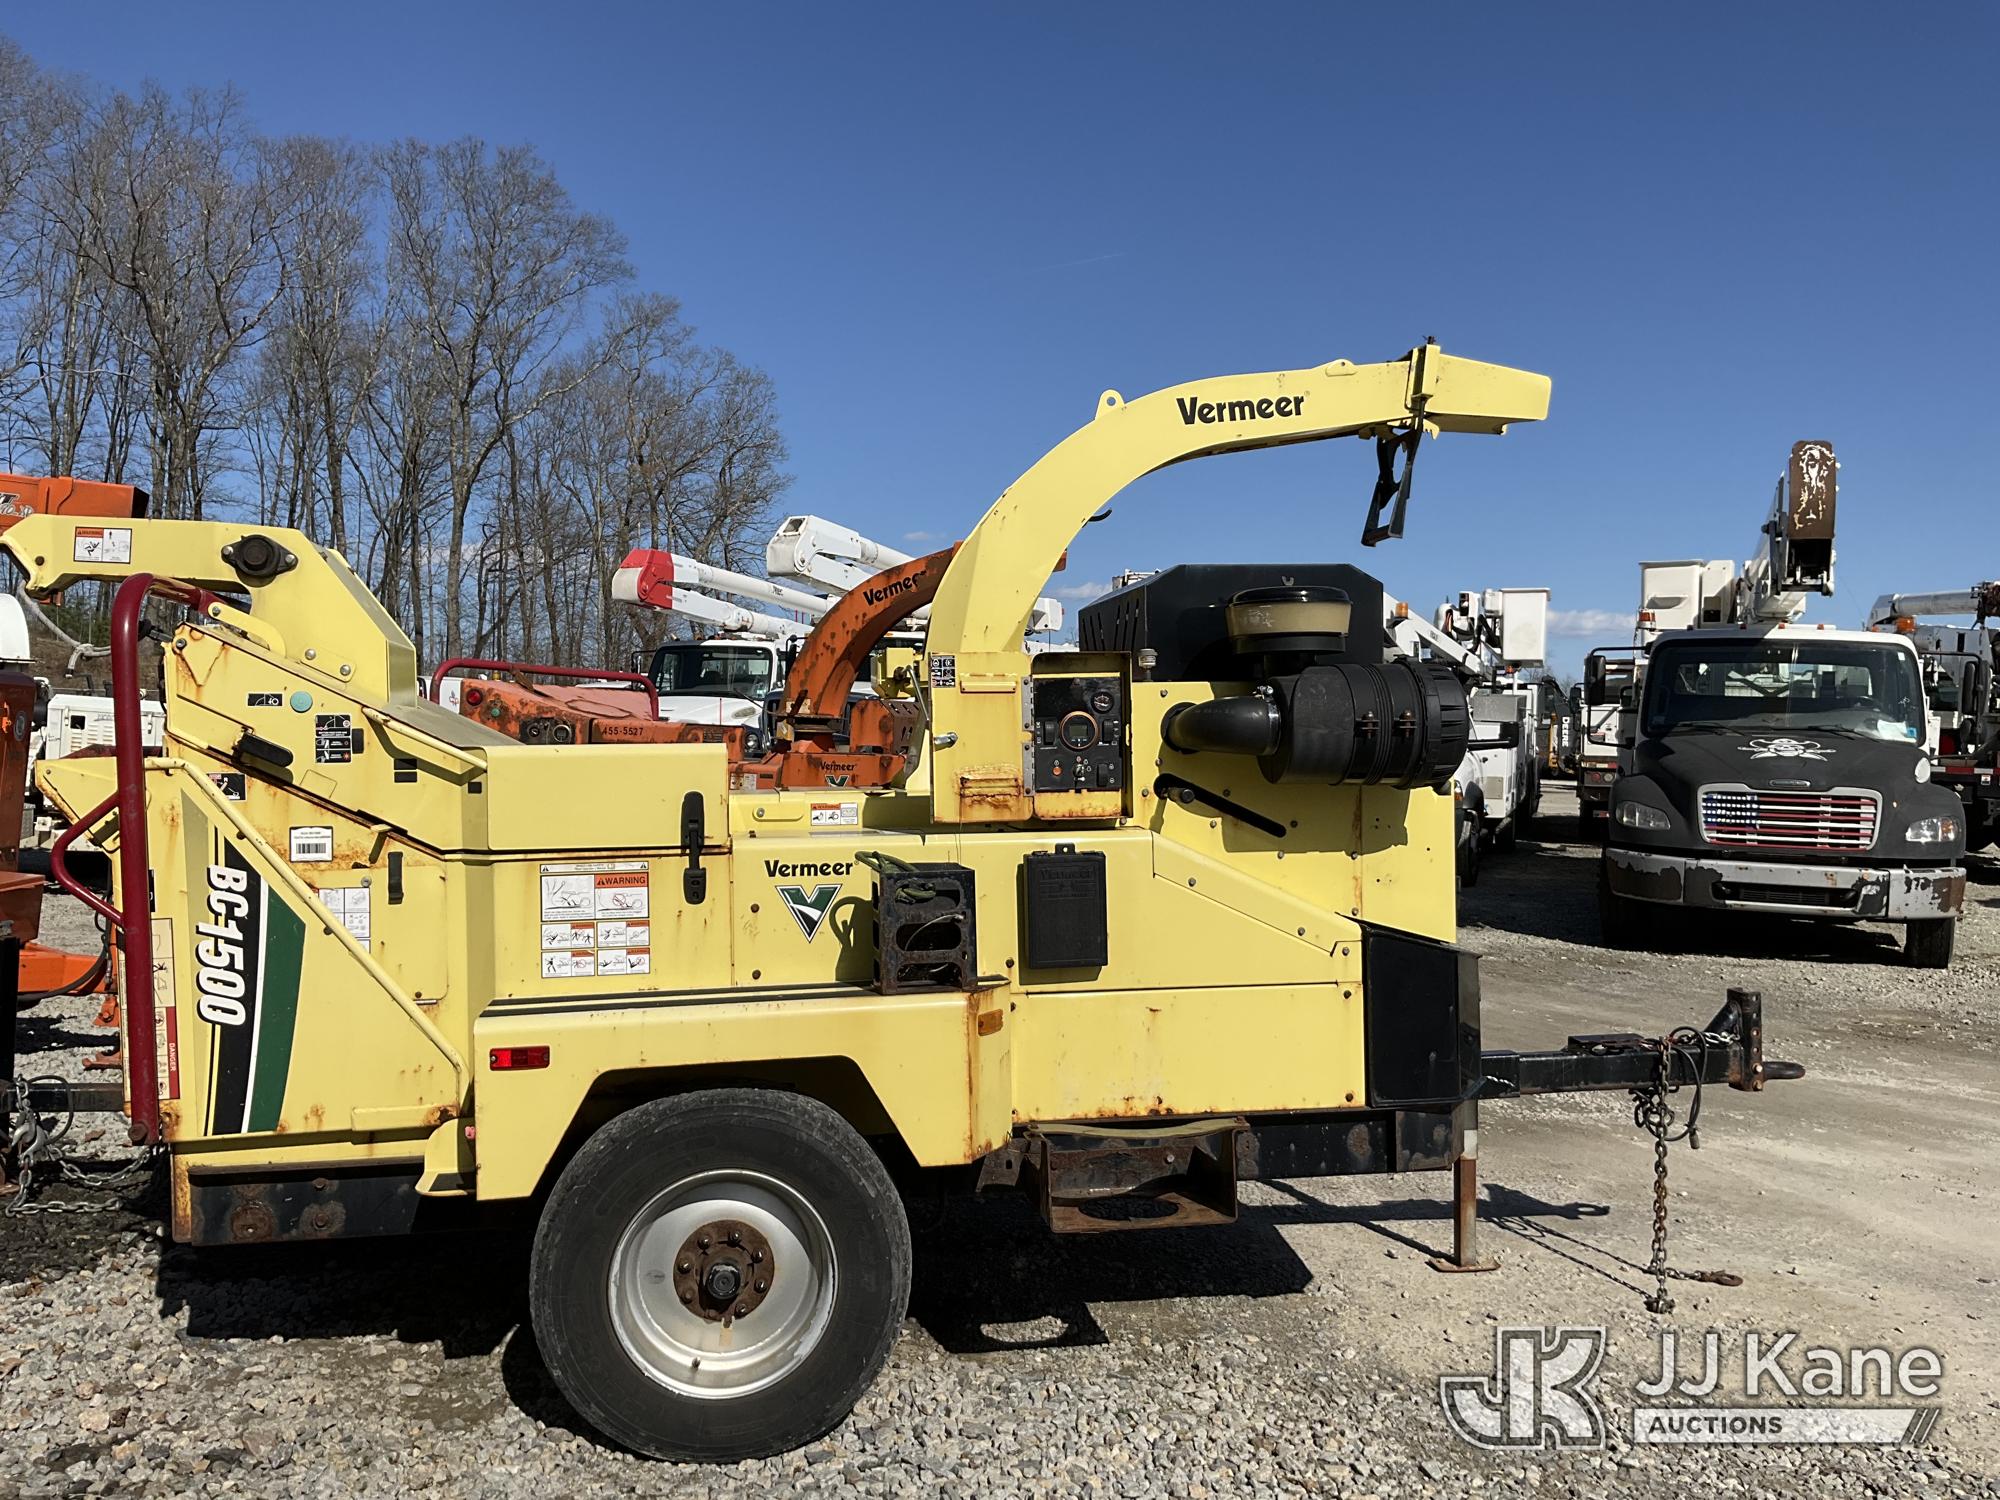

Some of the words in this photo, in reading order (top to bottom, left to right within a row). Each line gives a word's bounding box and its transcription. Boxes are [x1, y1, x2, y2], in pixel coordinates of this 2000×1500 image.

[1176, 395, 1304, 425] Vermeer
[863, 570, 926, 606] Verme
[602, 726, 644, 736] 455-5527
[1562, 716, 1570, 747] DEERE
[820, 761, 855, 771] Vermeer
[764, 859, 853, 877] Vermeer
[605, 876, 646, 886] WARNING
[169, 1042, 177, 1072] DANGER
